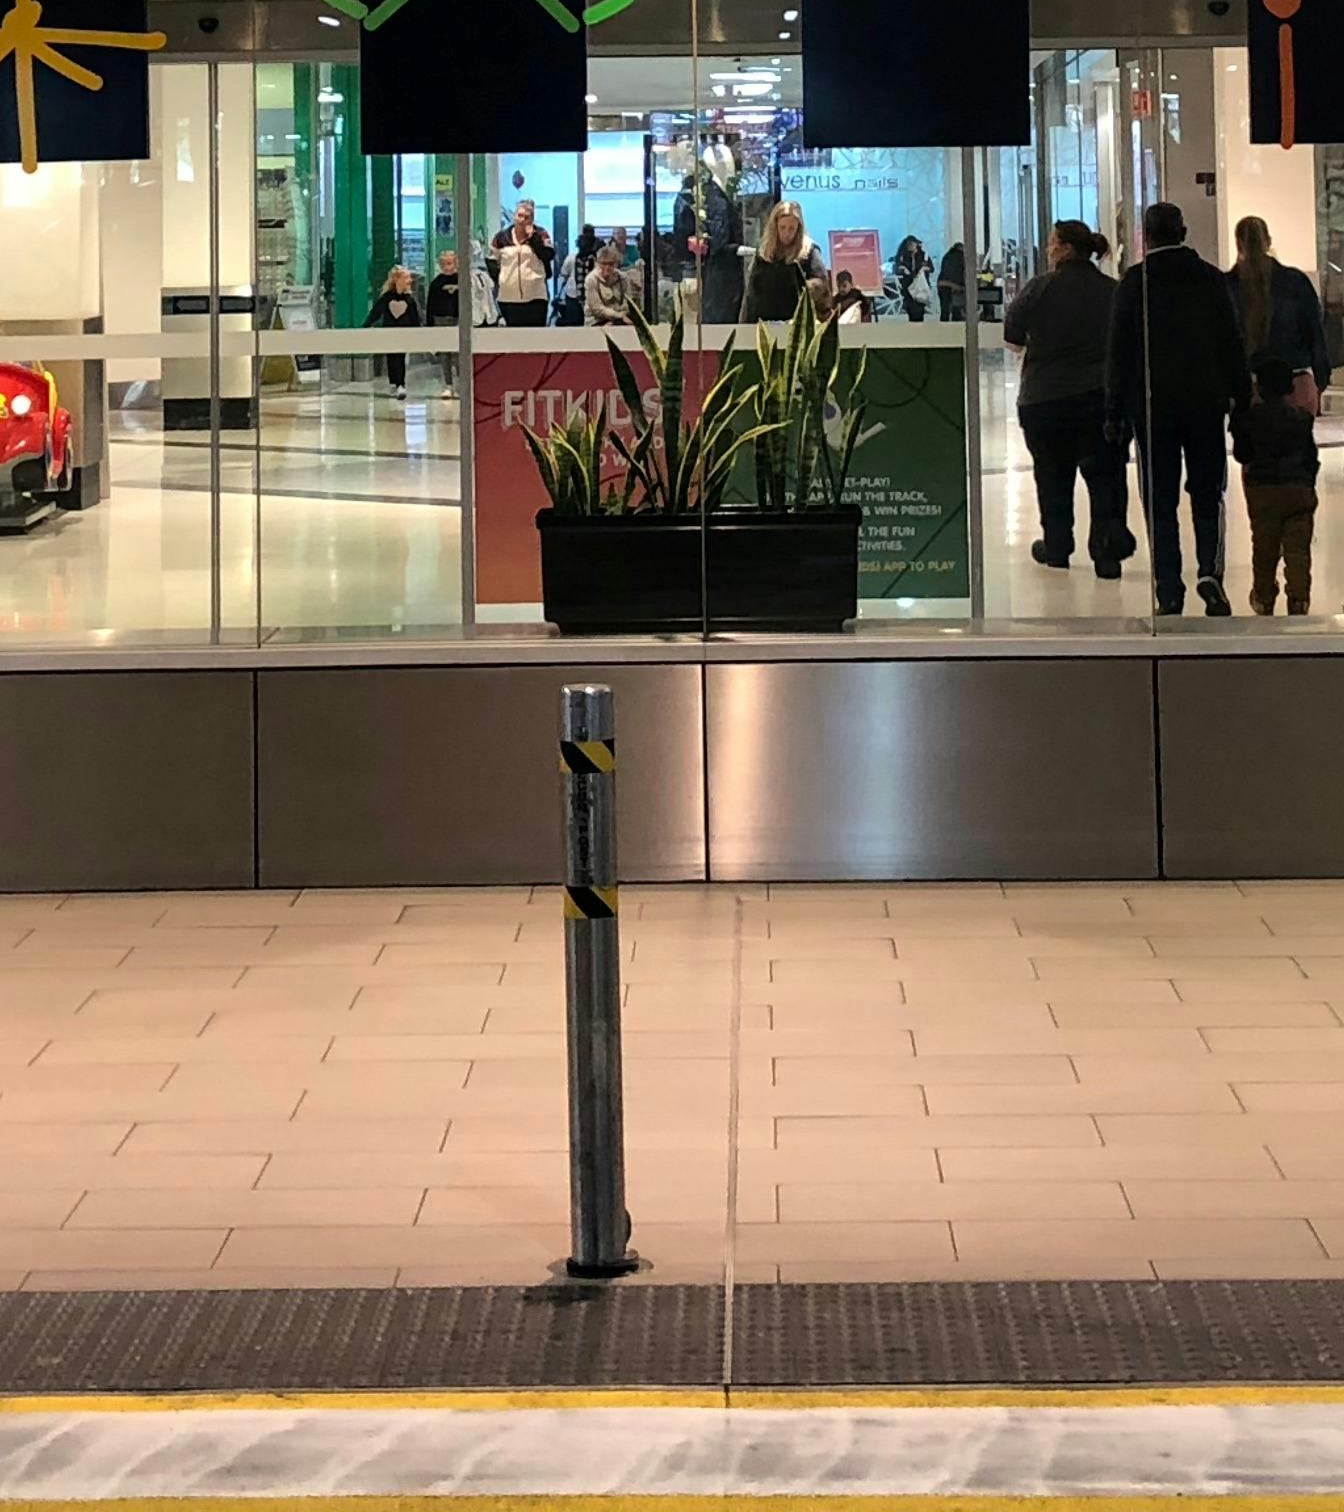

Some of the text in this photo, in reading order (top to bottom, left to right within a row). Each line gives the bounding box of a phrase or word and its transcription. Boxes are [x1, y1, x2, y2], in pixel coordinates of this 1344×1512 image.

[781, 174, 841, 189] venus
[865, 491, 885, 502] THE
[889, 491, 928, 503] TRACK,
[875, 505, 898, 516] WIN
[868, 526, 889, 537] THE
[892, 526, 916, 537] FUN
[884, 561, 906, 571] APP
[909, 561, 924, 572] TO
[928, 560, 955, 572] PLAY
